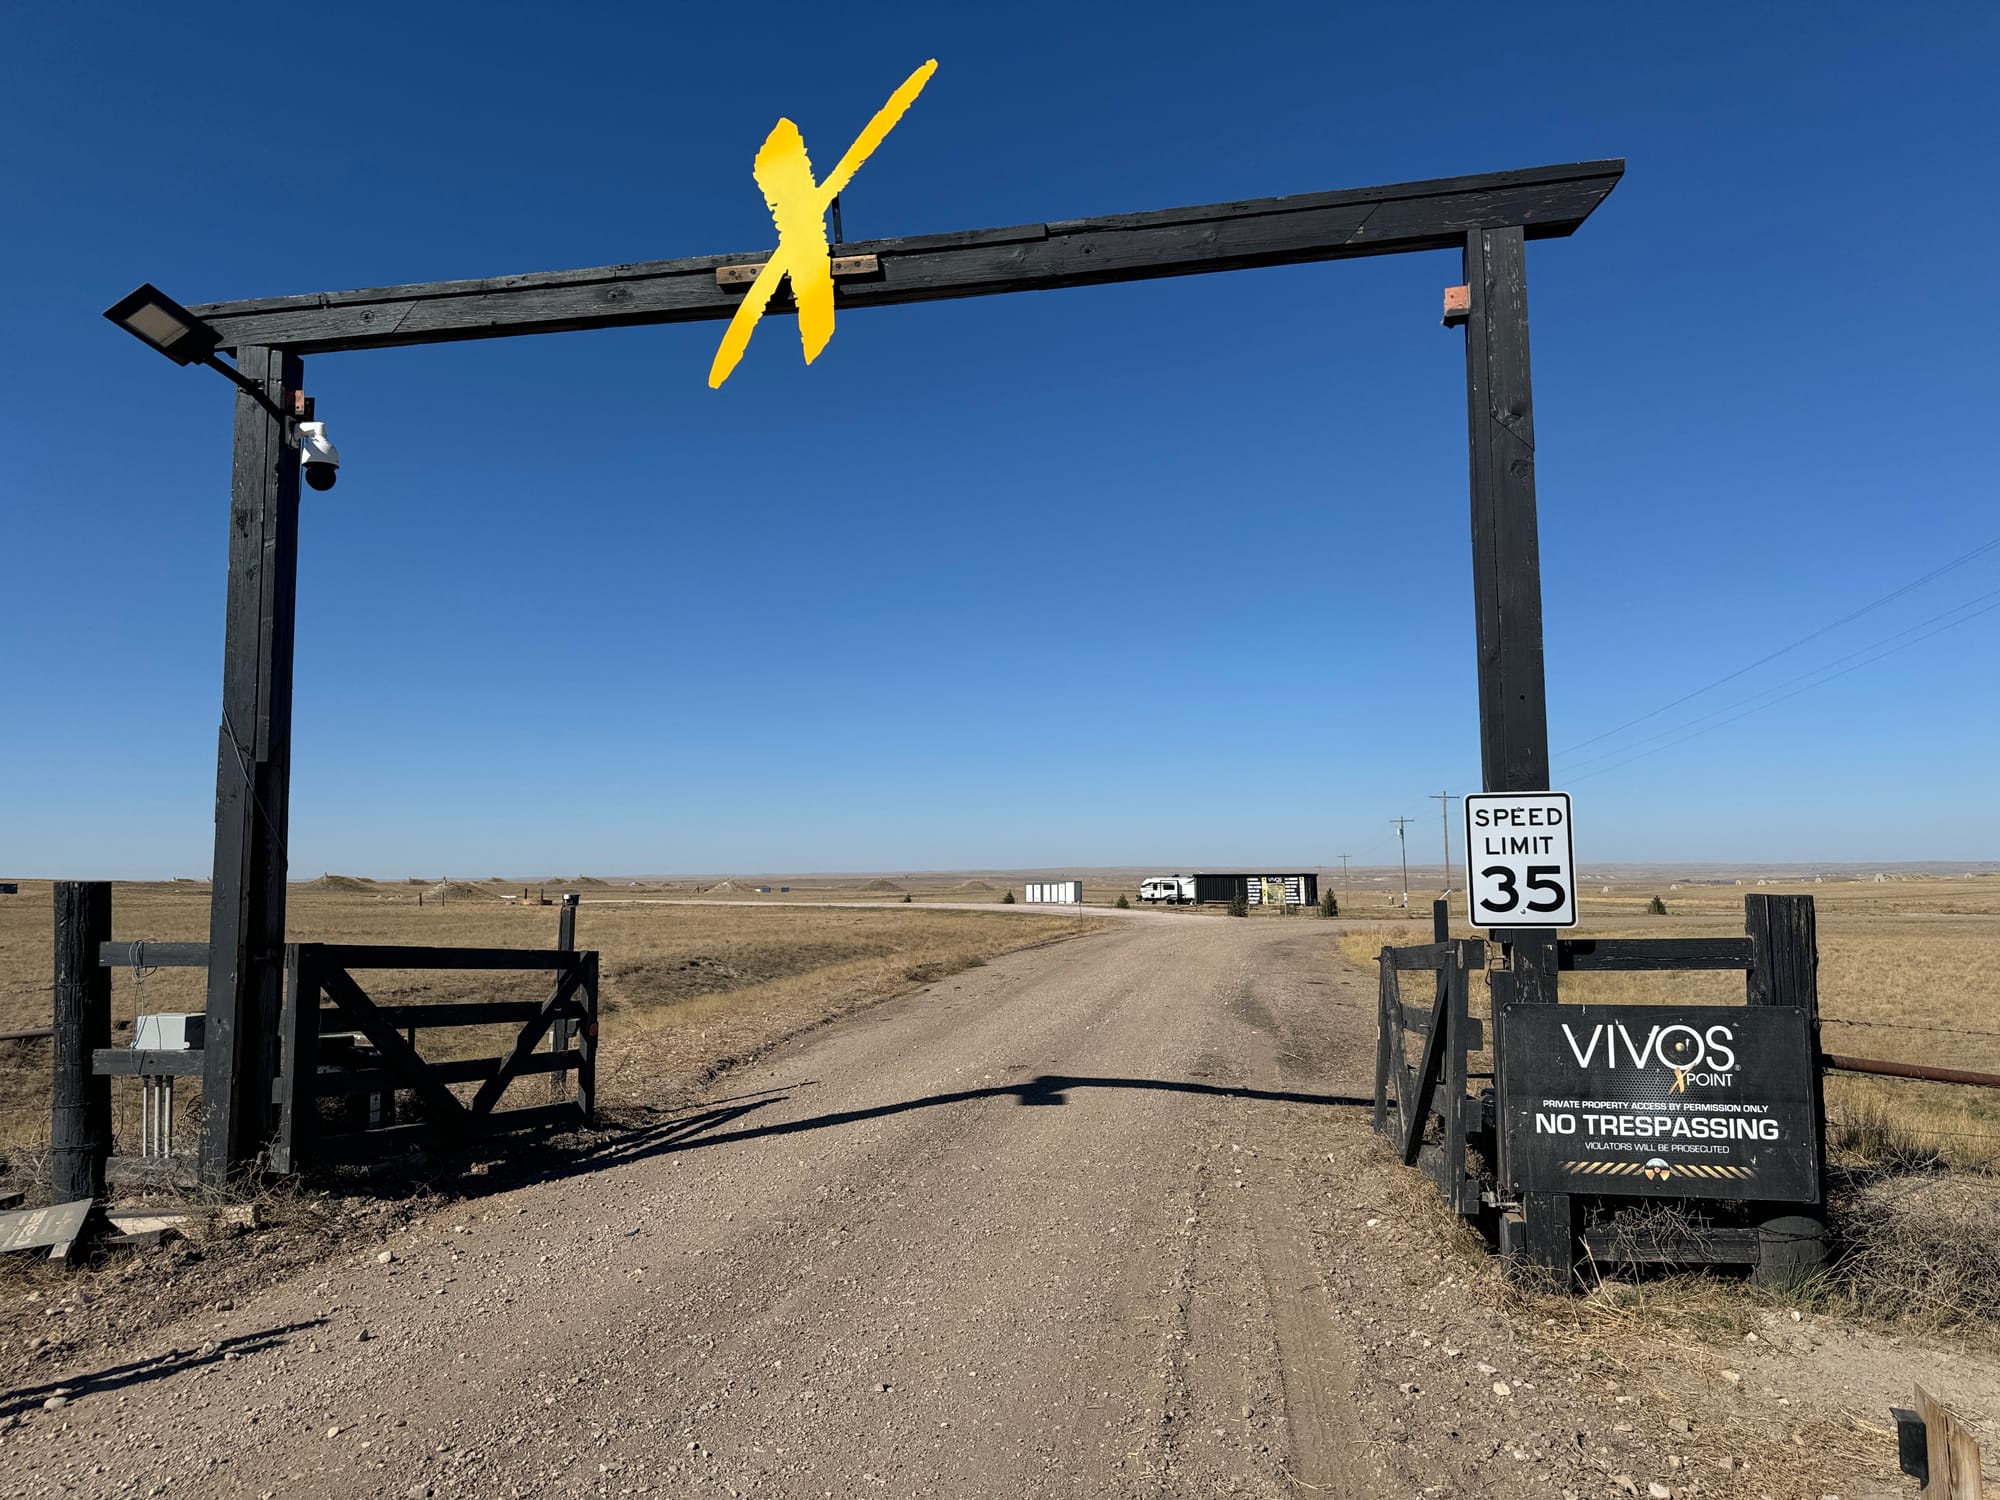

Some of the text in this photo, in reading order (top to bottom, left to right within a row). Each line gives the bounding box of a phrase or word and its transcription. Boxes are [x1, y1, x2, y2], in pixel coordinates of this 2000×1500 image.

[1475, 807, 1563, 827] SPEED
[1485, 836, 1554, 855] LIMIT
[1480, 865, 1566, 912] 35
[1543, 1100, 1769, 1113] PRIVATE PROPERTY ACCESS BY PERMISSION ONLY
[1535, 1113, 1779, 1140] NO TRESPASSING
[1585, 1142, 1730, 1154] VIOLATORS WILL BE PROSECUTED
